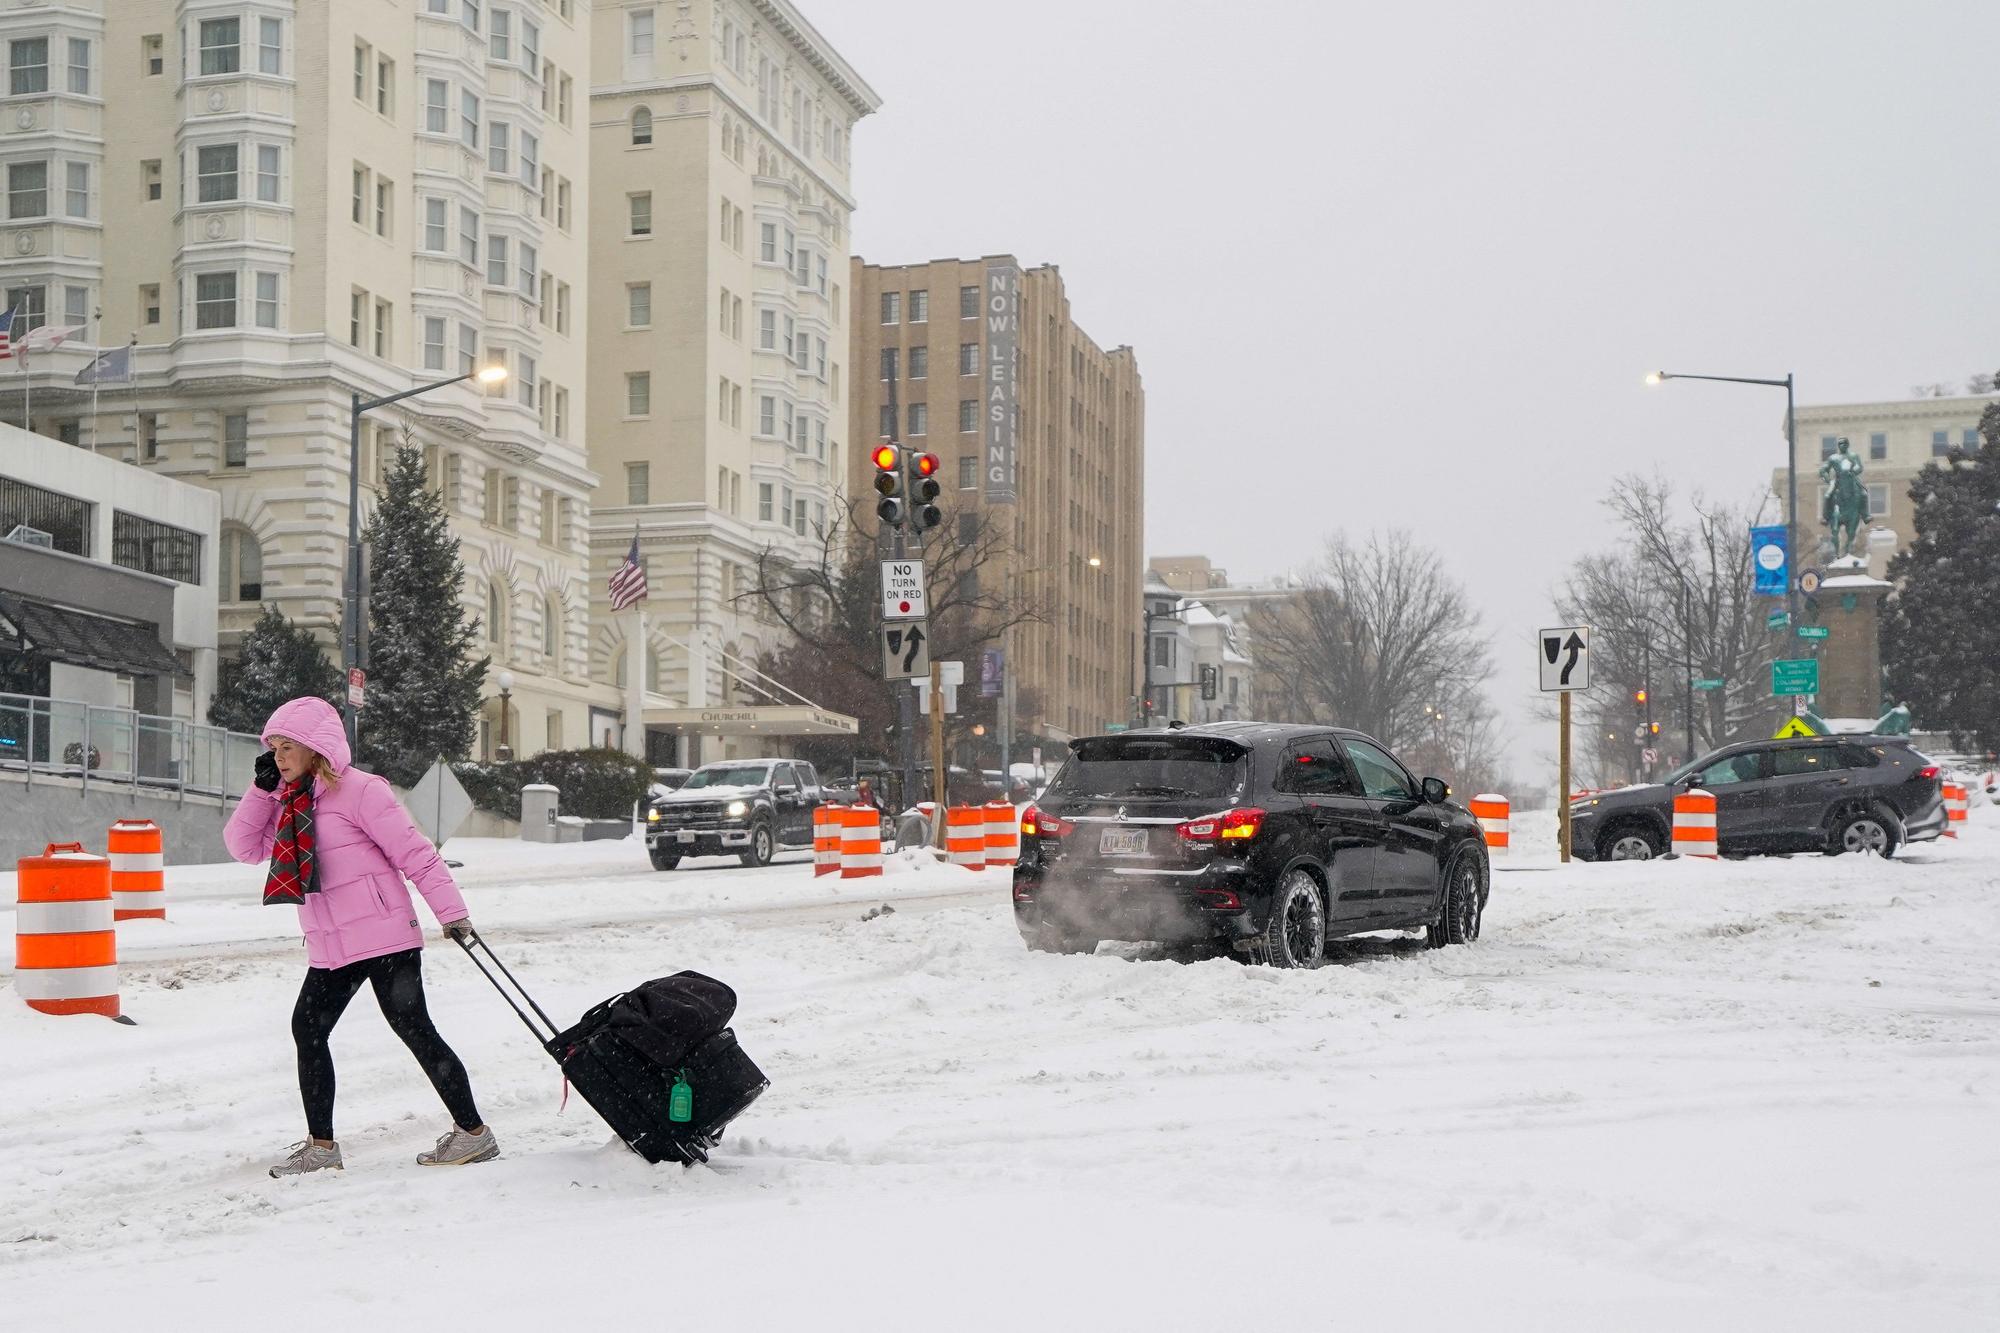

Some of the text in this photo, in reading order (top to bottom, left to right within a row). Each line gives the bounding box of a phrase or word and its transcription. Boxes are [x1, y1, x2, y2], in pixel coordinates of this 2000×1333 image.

[988, 275, 1008, 482] NOW LEASING
[893, 565, 912, 575] NO
[891, 578, 916, 587] TURN
[886, 589, 922, 599] ON RED
